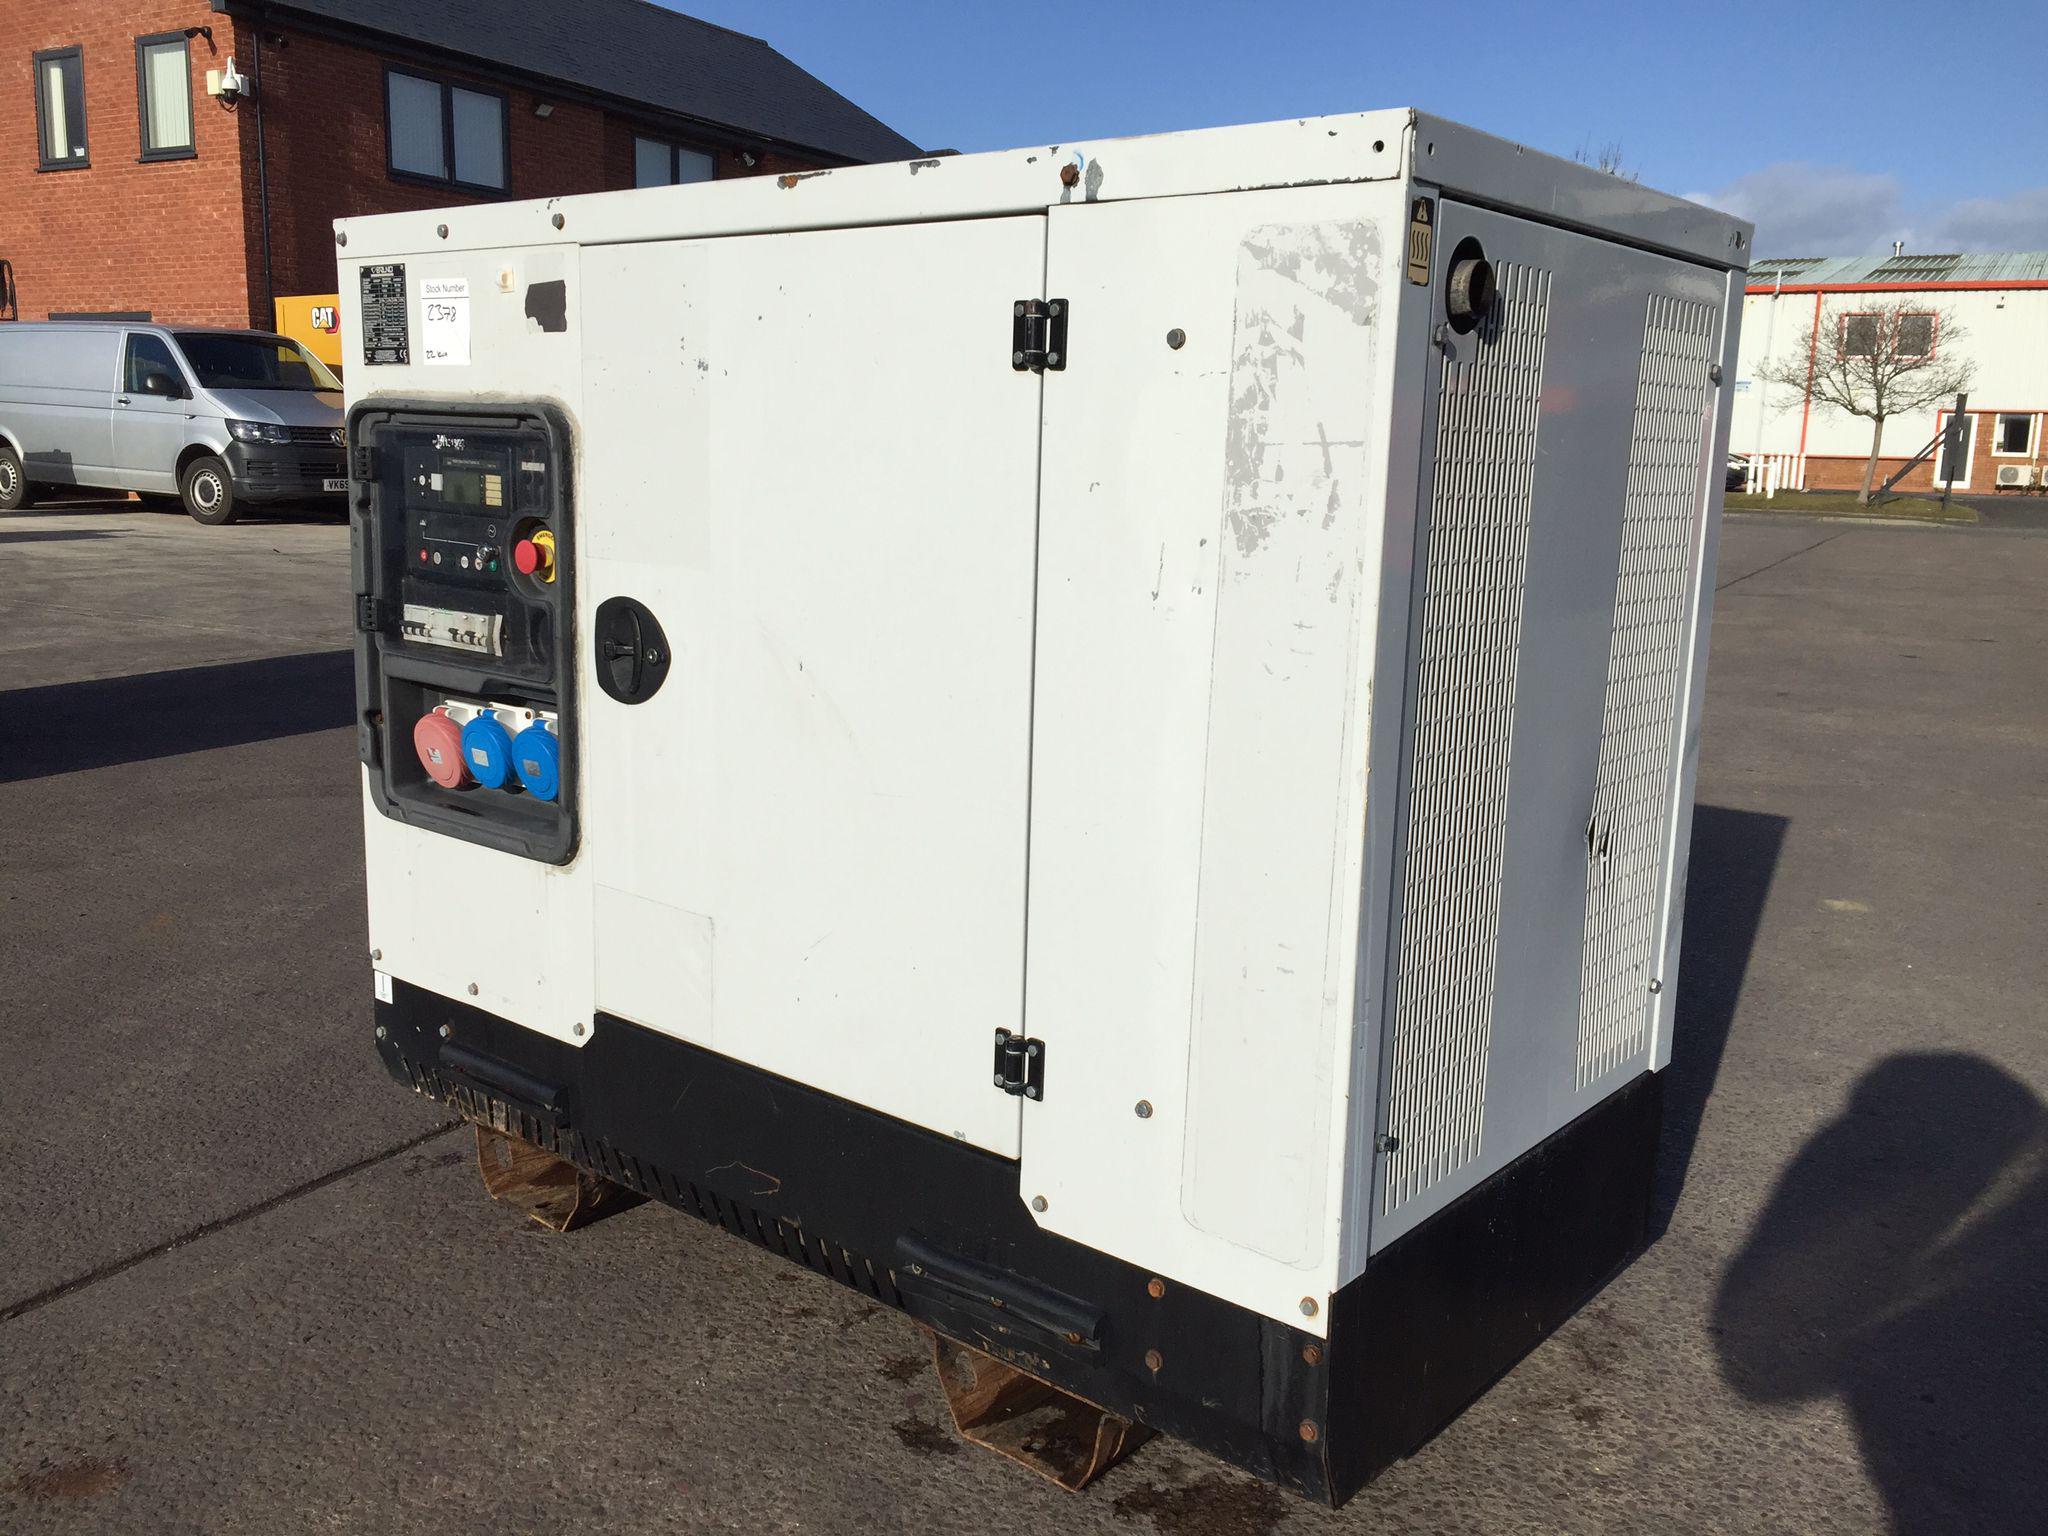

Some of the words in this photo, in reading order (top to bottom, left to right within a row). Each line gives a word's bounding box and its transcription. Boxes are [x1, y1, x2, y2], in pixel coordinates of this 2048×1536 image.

[425, 284, 441, 293] Stock
[442, 284, 465, 293] Number
[311, 307, 334, 329] CAT
[427, 304, 457, 323] 2378
